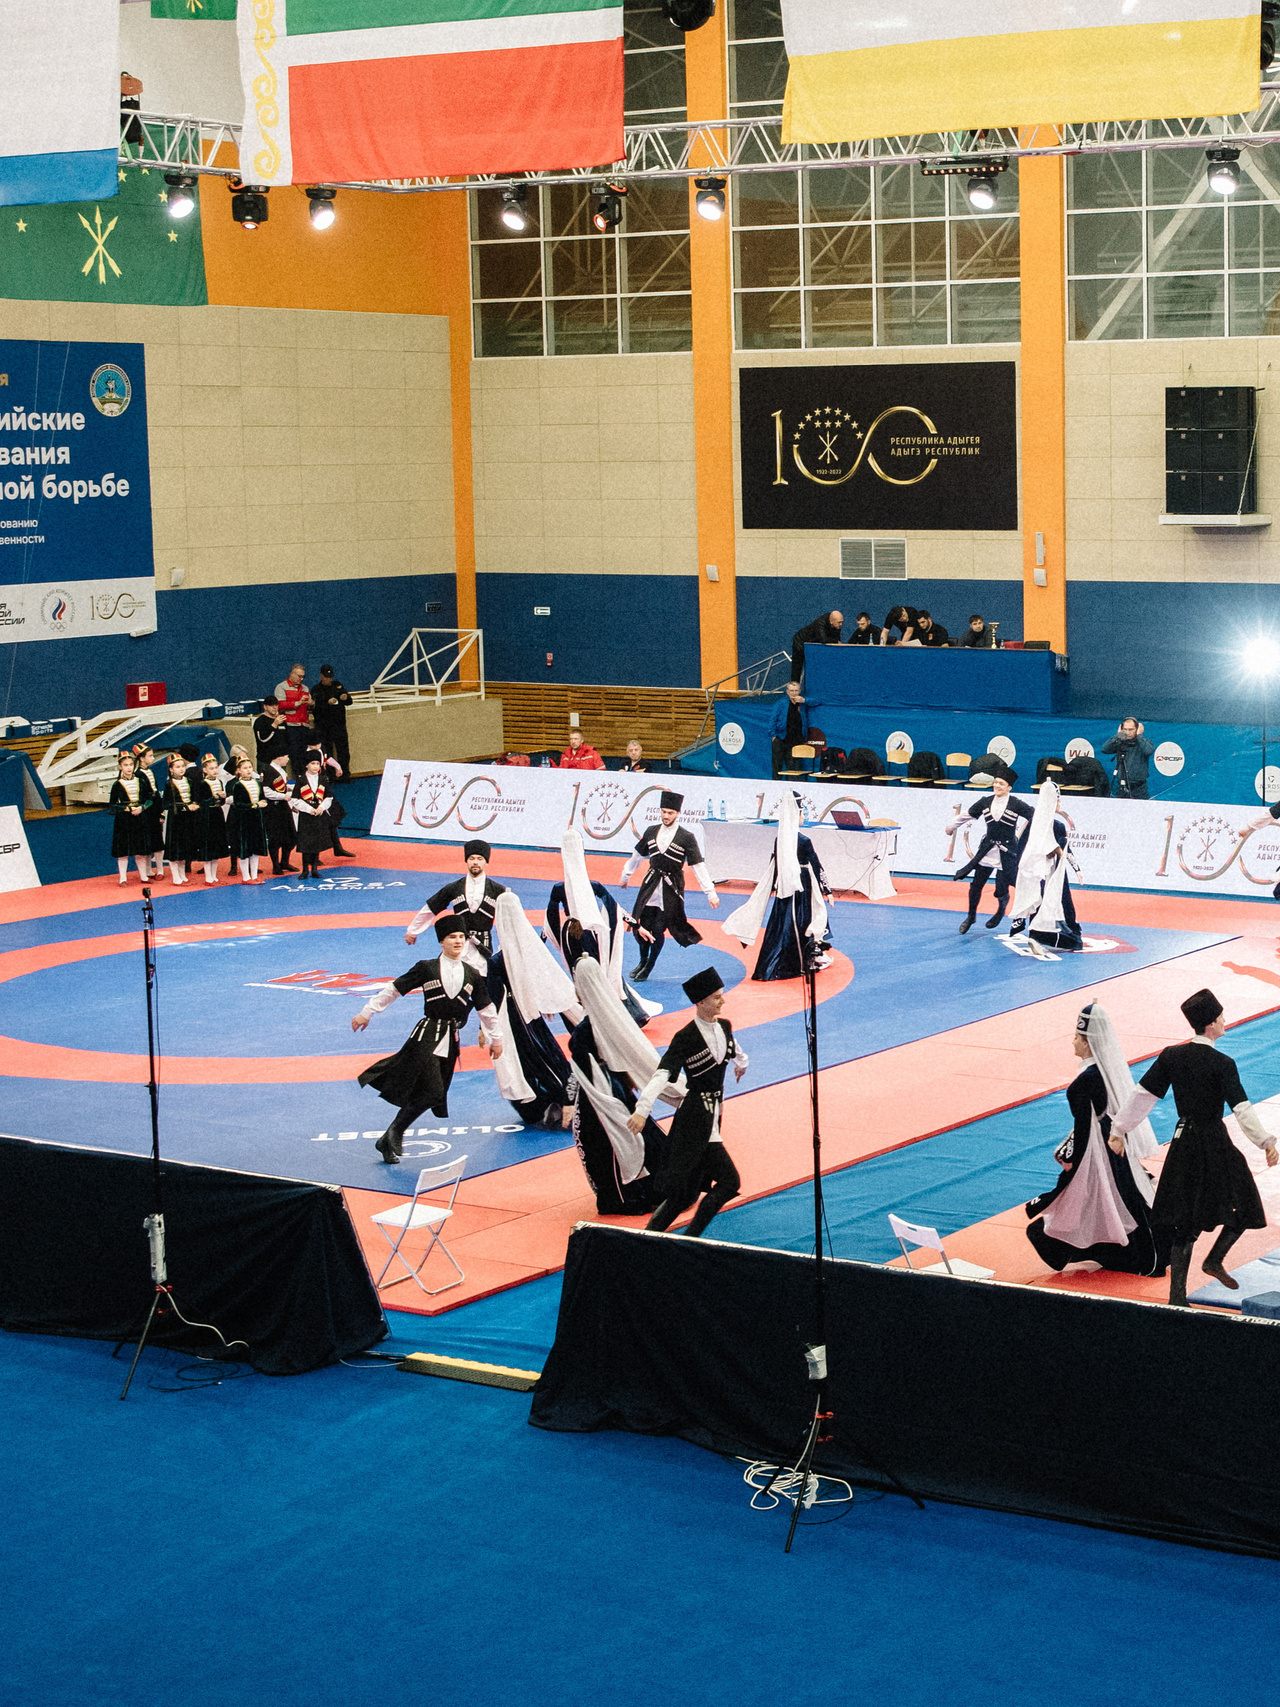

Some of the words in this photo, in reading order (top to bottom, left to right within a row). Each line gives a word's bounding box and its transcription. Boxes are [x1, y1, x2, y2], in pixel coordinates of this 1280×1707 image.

[0, 405, 86, 431] ийские
[890, 436, 945, 446] РЕСПУБЛИКА
[947, 435, 981, 445] АДЫГЕЯ
[0, 446, 71, 466] вания
[890, 447, 921, 457] АДЫГЭ
[925, 446, 981, 456] РЕСПУБЛИК
[0, 474, 35, 501] ой
[41, 472, 130, 505] борьбе
[471, 796, 505, 804] РЕСПУБЛИКА
[490, 805, 524, 813] РЕСПУБЛИК
[644, 814, 662, 822] АДЫГ
[1081, 833, 1107, 841] АДЫГЕЯ
[1068, 840, 1105, 849] ЕСПУБЛИК
